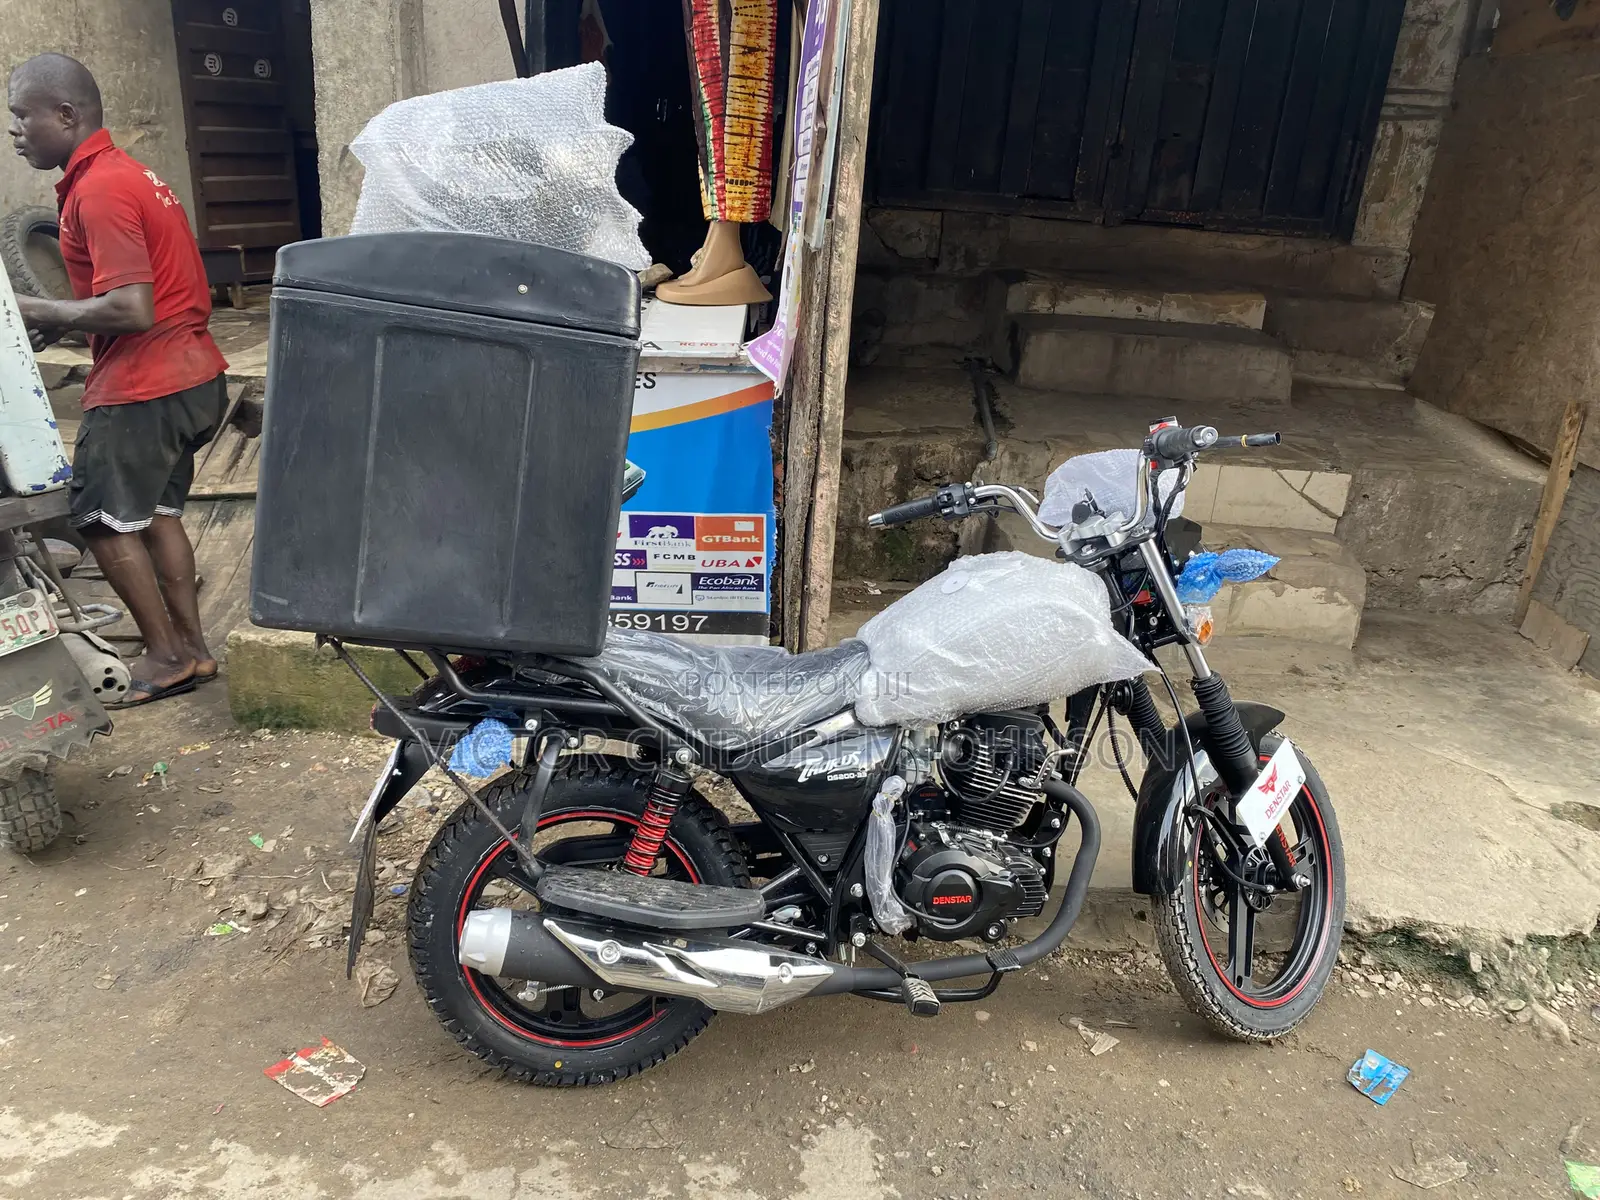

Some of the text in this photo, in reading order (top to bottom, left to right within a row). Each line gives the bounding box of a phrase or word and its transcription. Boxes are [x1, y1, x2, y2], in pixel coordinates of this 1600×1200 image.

[634, 540, 691, 548] FirstBank
[701, 535, 760, 543] GTBank
[701, 559, 740, 567] UBA
[699, 574, 759, 586] Ecobank
[1264, 780, 1292, 820] DENSTAR
[1276, 823, 1297, 868] ENSTAR
[933, 895, 972, 905] DENSTAR
